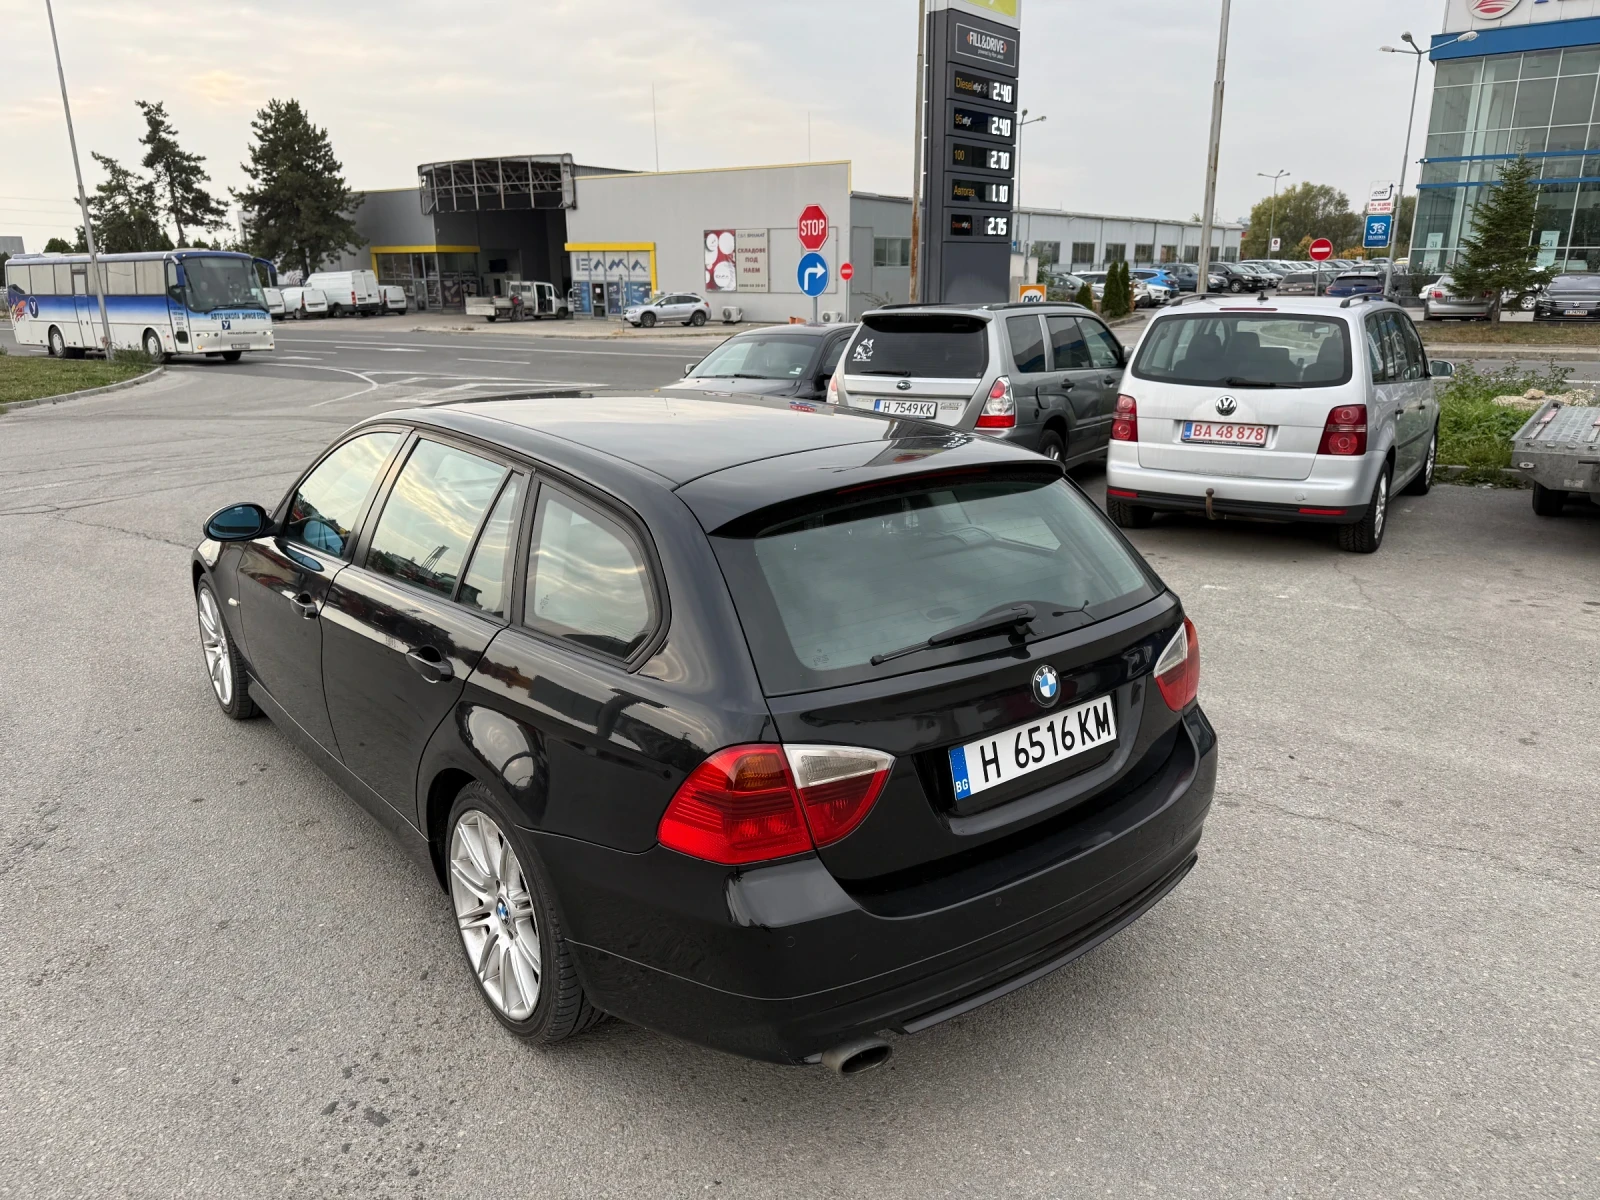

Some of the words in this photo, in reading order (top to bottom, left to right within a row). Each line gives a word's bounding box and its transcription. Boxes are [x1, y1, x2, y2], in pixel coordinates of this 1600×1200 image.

[970, 32, 1004, 53] FILL&DRIVE
[993, 82, 1012, 103] 2.40
[992, 117, 1011, 136] 2.40
[954, 150, 964, 160] 100
[990, 150, 1010, 170] 2.70
[954, 185, 975, 196] Автогаз
[992, 184, 1008, 202] 1.10
[800, 219, 825, 236] STOP
[988, 217, 1007, 235] 2.75
[884, 401, 891, 412] H
[1193, 424, 1212, 437] BA
[1216, 425, 1234, 439] 48
[1236, 426, 1264, 441] 878
[1036, 667, 1057, 682] BMW
[980, 740, 1002, 782] H
[956, 778, 968, 792] BG
